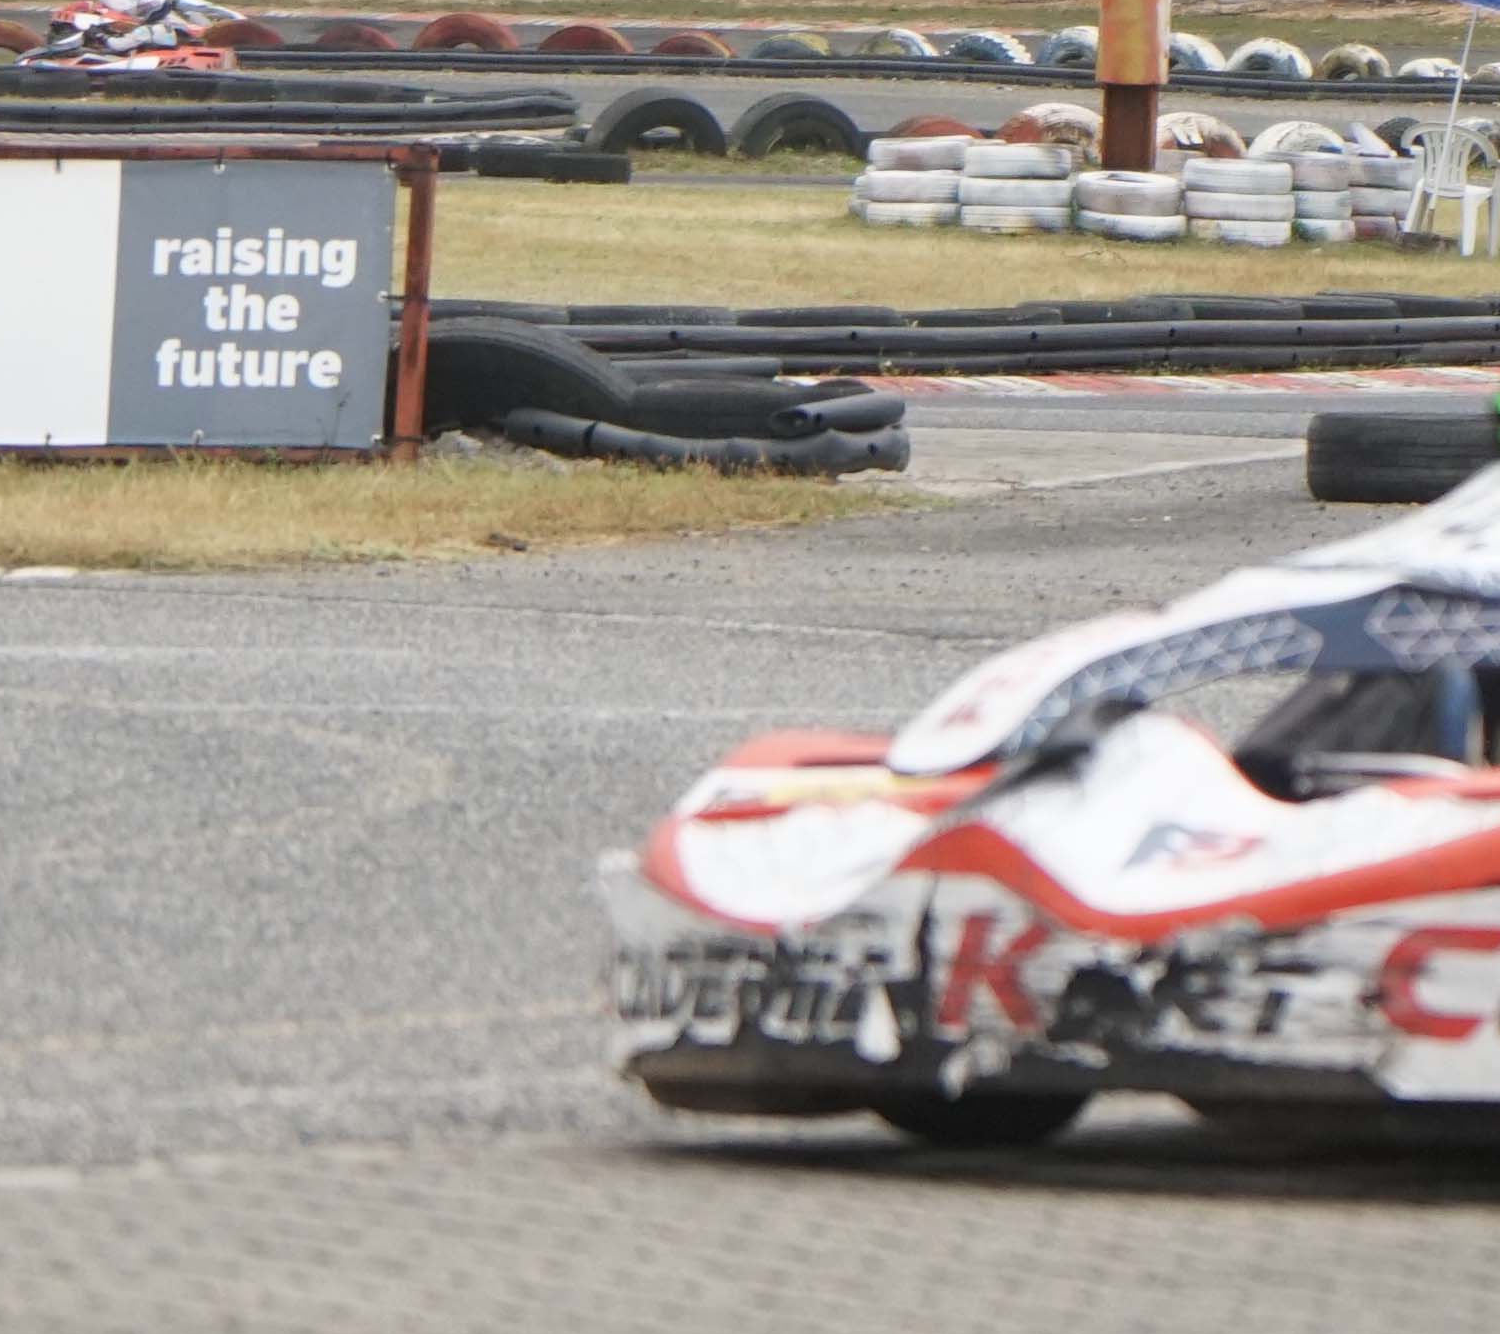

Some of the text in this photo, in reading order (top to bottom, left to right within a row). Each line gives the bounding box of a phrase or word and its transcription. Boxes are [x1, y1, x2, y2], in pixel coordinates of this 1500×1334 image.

[152, 226, 359, 289] raising
[203, 283, 302, 333] the
[155, 337, 344, 389] future
